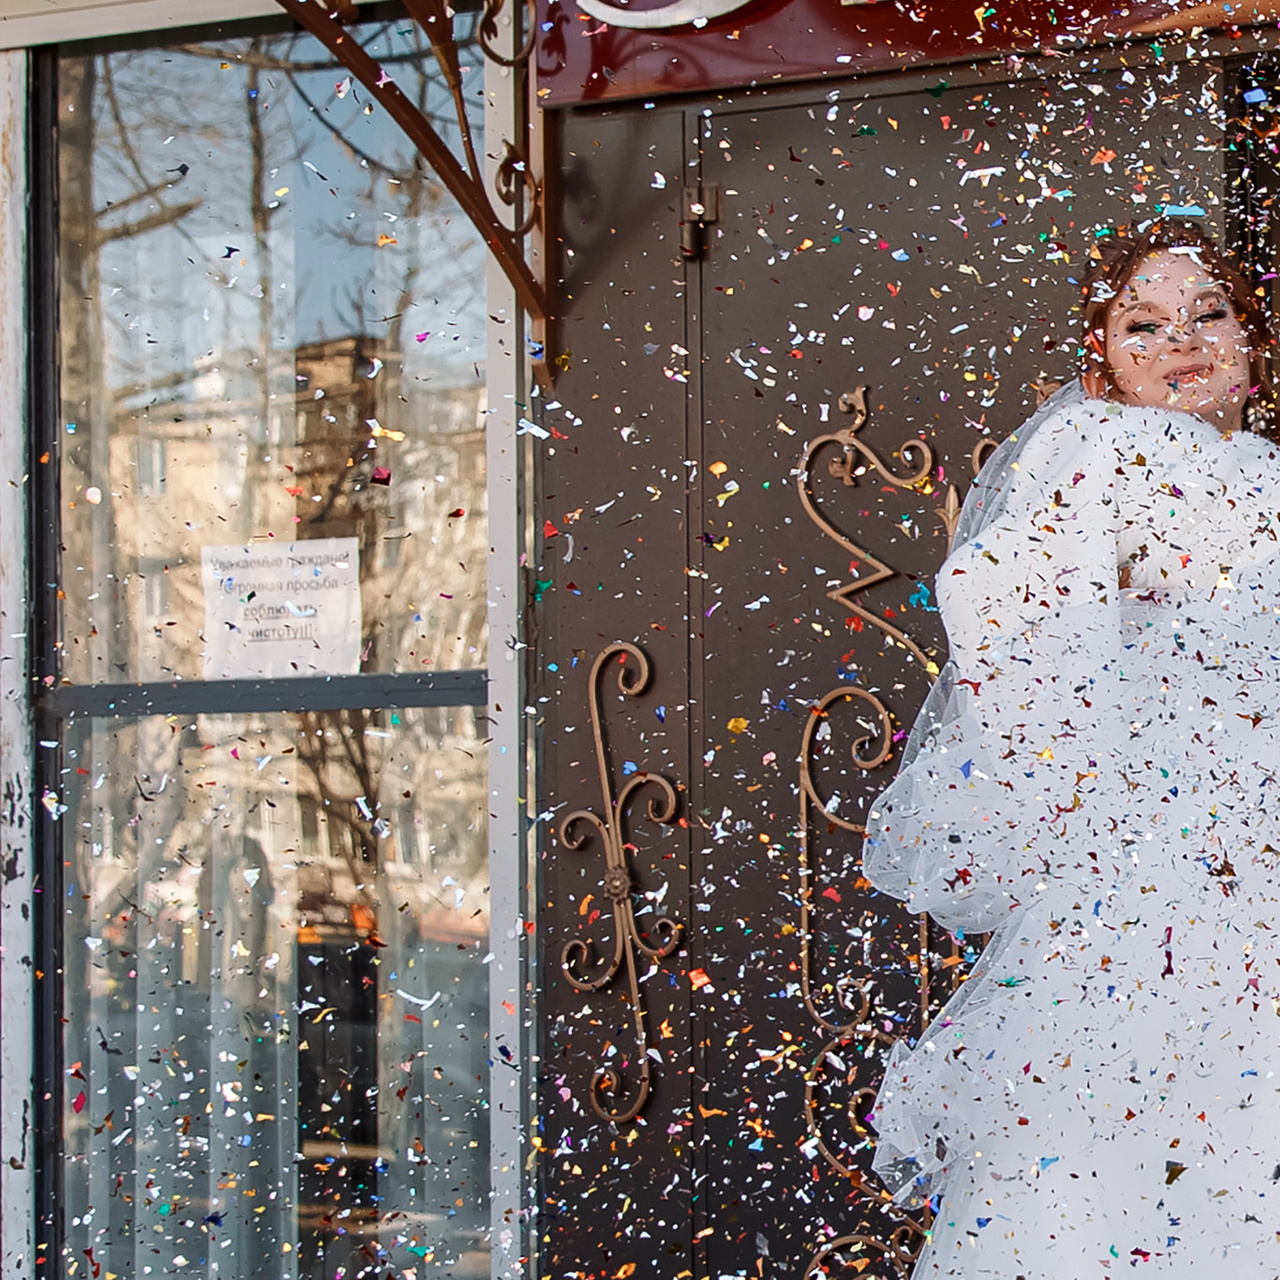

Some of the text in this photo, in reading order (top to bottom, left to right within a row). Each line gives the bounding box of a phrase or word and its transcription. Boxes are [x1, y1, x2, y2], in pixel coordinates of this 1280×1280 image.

[210, 555, 283, 571] Уважаемые
[286, 576, 339, 594] просьба
[243, 603, 318, 619] соблюать
